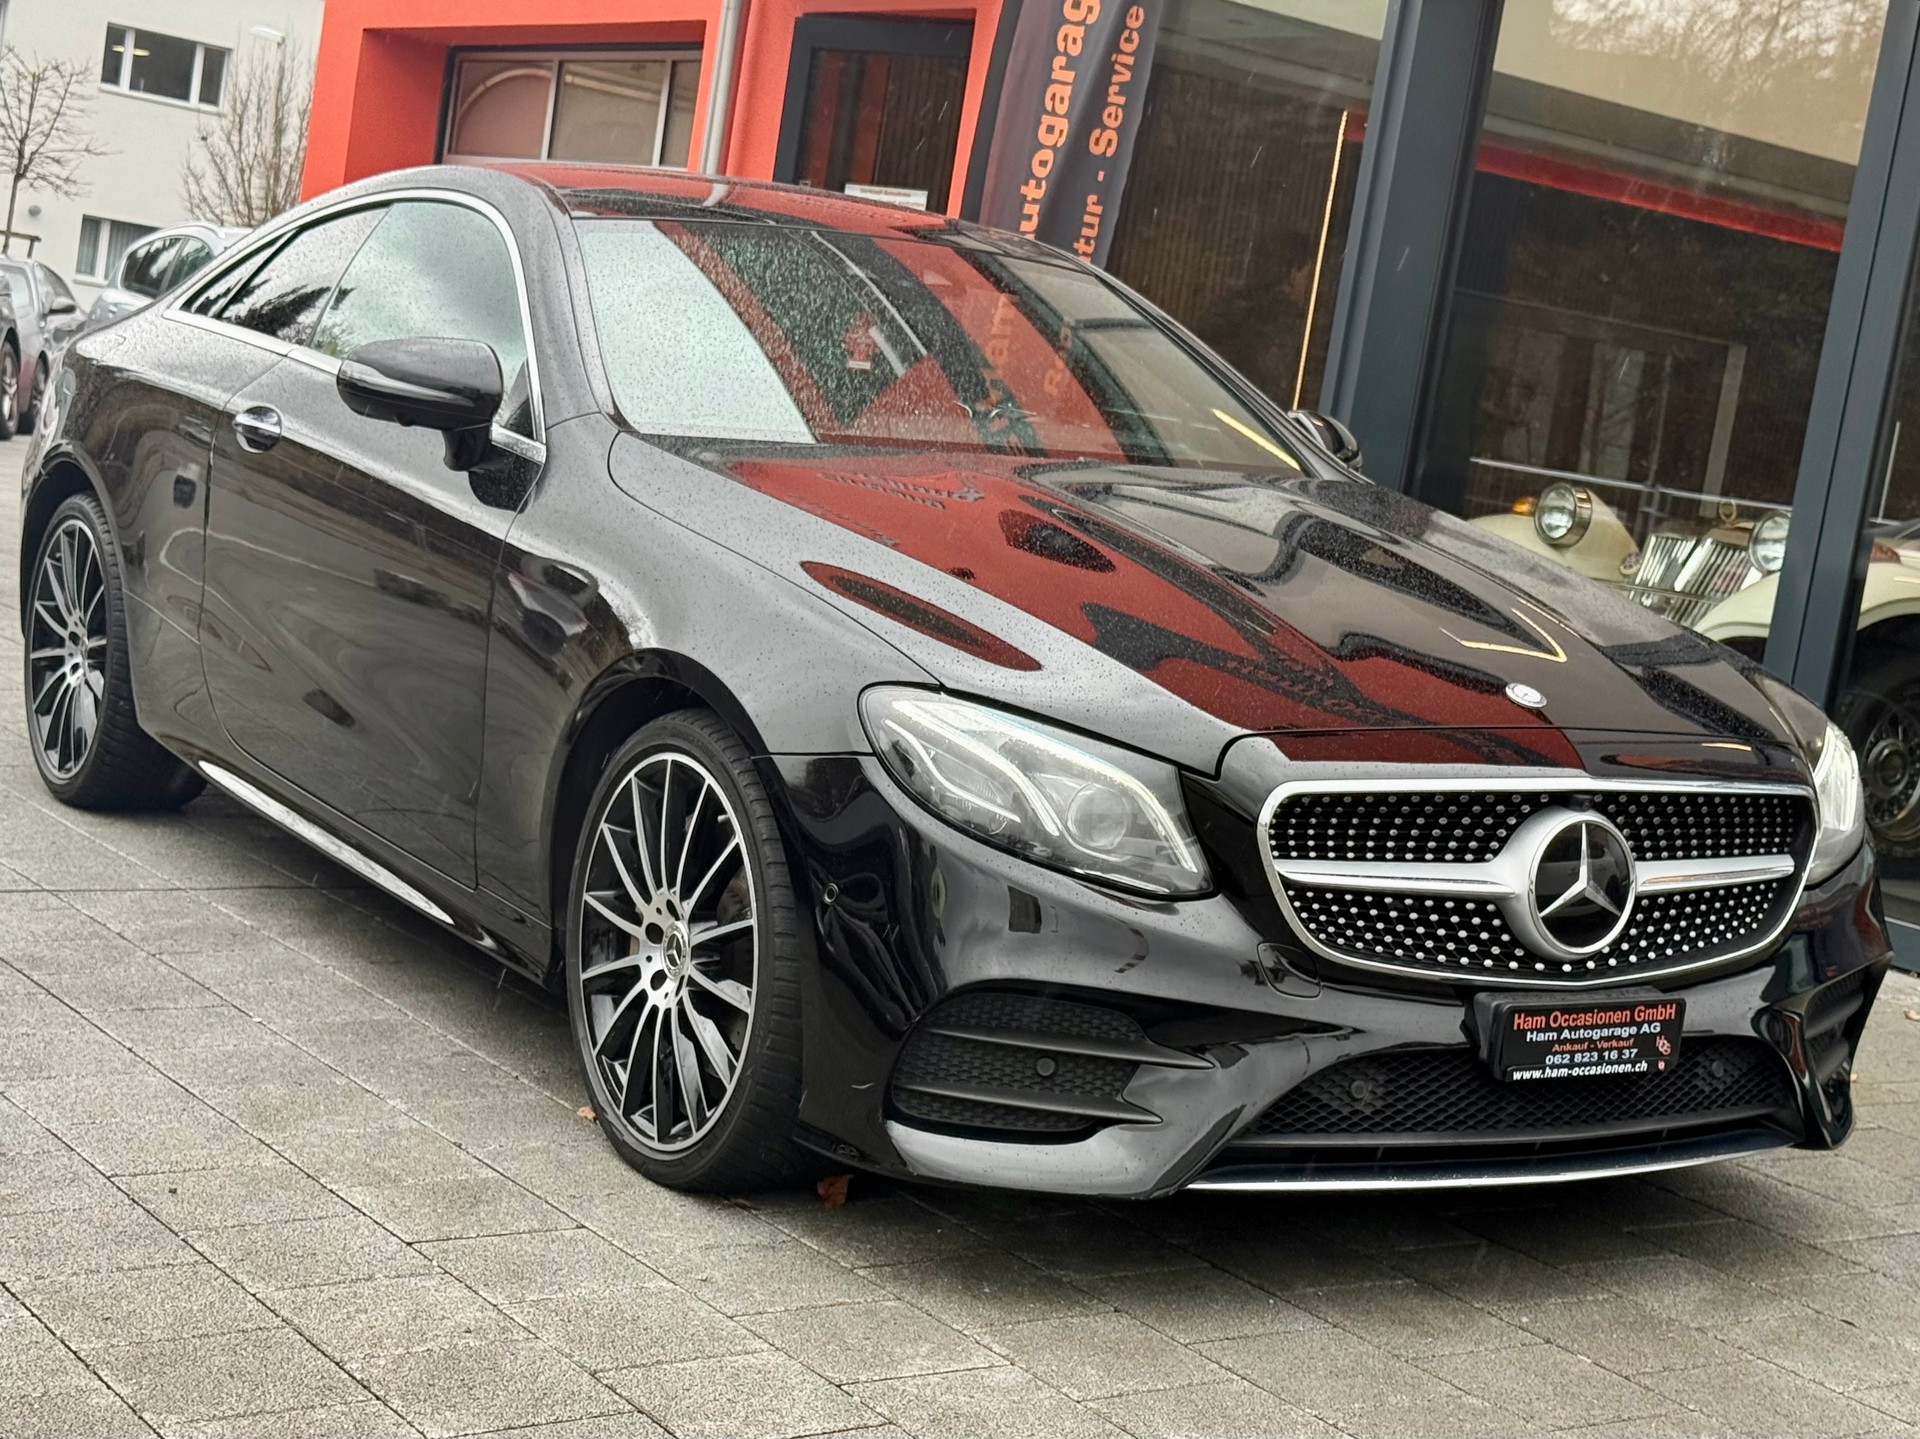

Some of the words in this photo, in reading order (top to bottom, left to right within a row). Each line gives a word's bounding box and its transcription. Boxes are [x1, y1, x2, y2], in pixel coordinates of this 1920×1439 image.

[1088, 5, 1145, 158] Service
[1018, 0, 1101, 240] utogarag
[1073, 194, 1104, 264] tur
[1513, 1012, 1546, 1030] Ham
[1550, 1008, 1631, 1028] Occasionen
[1634, 1003, 1676, 1023] GmbH
[1526, 1031, 1557, 1042] Ham
[1560, 1026, 1638, 1041] Autogarage
[1639, 1022, 1661, 1034] AG
[1545, 1054, 1570, 1065] 062
[1574, 1051, 1599, 1063] 823
[1602, 1049, 1619, 1061] 16
[1621, 1048, 1638, 1060] 37
[1552, 1041, 1588, 1052] Ankauf
[1597, 1037, 1635, 1050] Verkauf
[1512, 1060, 1648, 1081] www.ham-occasionen.ch
